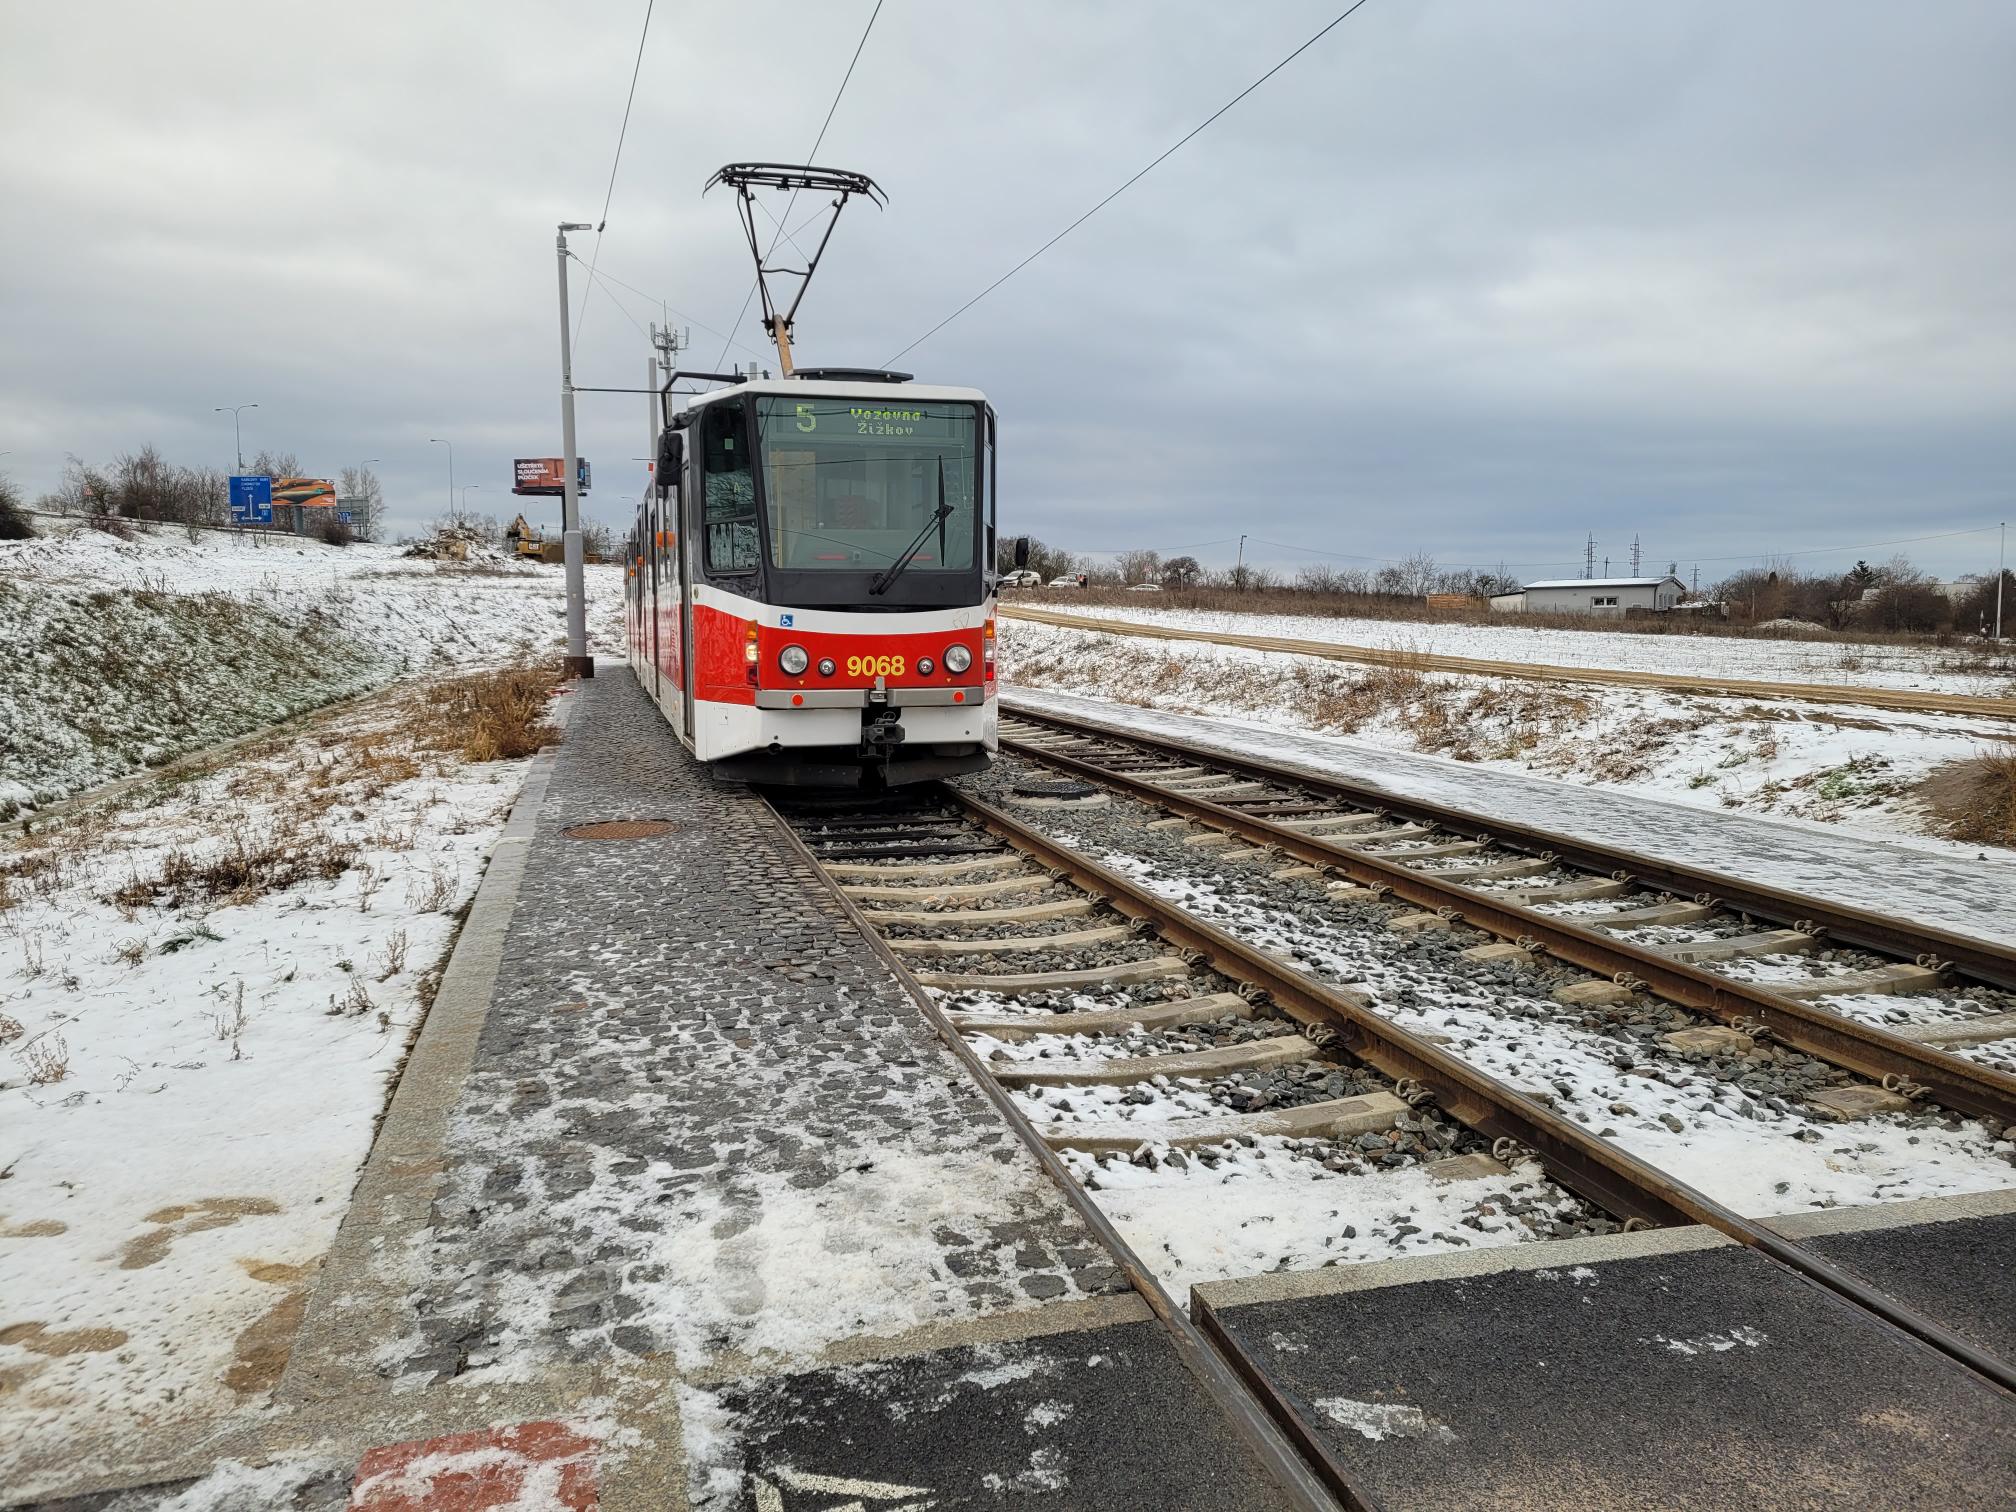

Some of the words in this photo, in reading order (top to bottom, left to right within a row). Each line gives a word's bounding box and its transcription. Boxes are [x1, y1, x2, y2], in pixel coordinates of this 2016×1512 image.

[796, 403, 817, 433] 5
[850, 408, 922, 422] Vozovna
[857, 419, 914, 436] Žižkov
[847, 655, 905, 677] 9068
